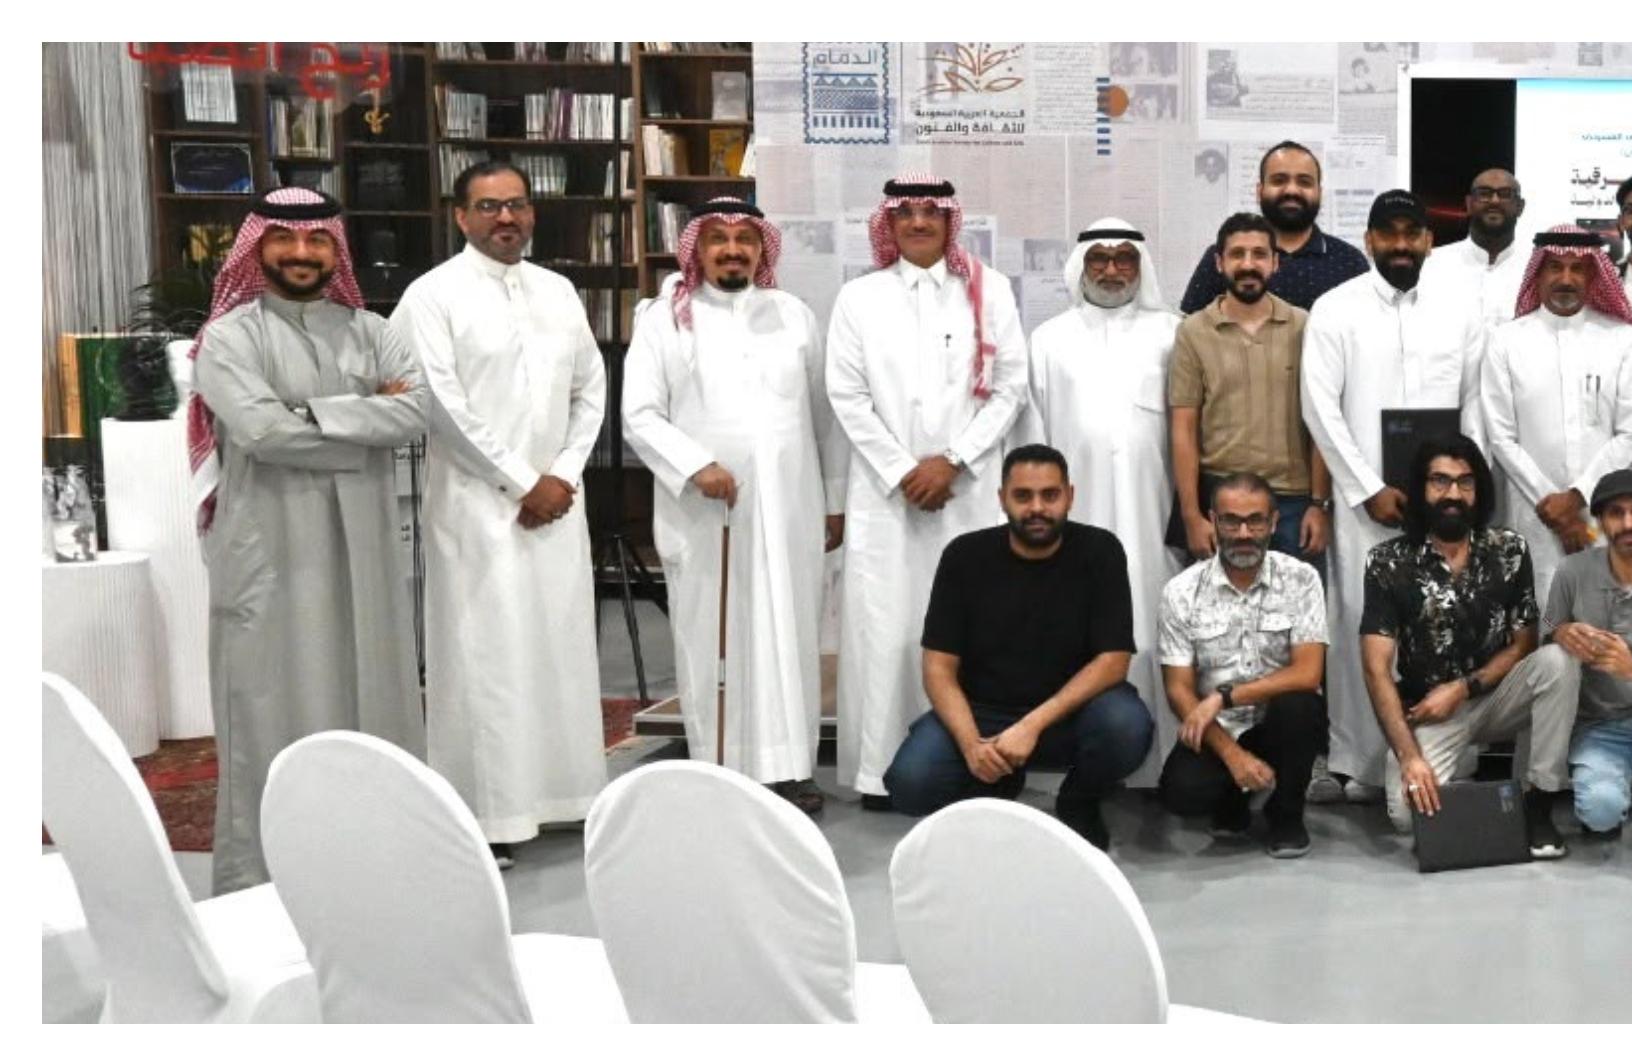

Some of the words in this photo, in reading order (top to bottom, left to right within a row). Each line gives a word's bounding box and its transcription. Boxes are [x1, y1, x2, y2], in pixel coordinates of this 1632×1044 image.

[812, 48, 877, 68] الدمام
[915, 121, 970, 136] والفنون
[971, 121, 1025, 135] للثقافة
